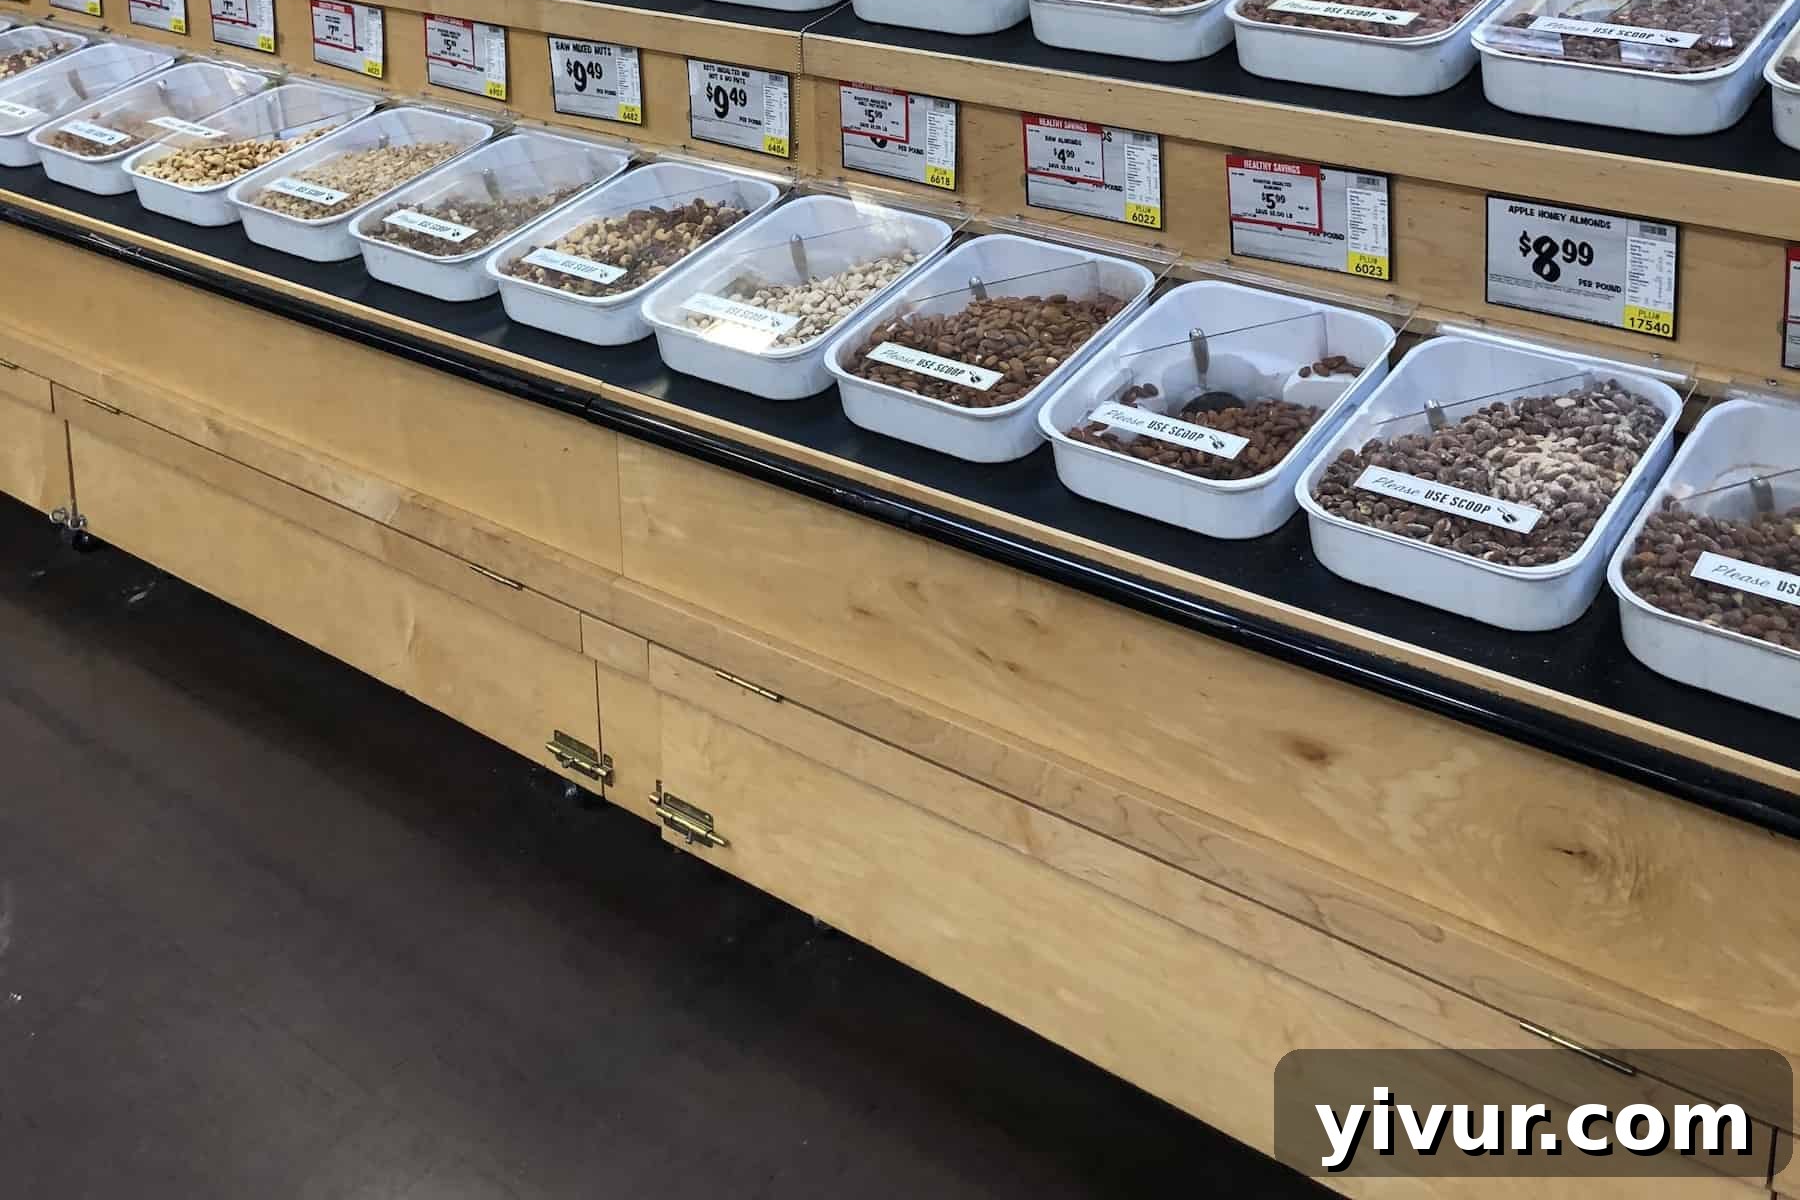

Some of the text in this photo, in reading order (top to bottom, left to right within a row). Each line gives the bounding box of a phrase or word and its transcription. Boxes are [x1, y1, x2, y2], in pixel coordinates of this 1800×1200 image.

[1593, 26, 1614, 35] USE
[1616, 29, 1655, 39] SCOOP
[1039, 118, 1088, 132] HEALTHY SAVINGS
[1244, 159, 1301, 174] HEALTHY SAVINGS
[1132, 213, 1155, 225] 6022
[1508, 205, 1611, 230] APPLE HONEY ALMONDS
[1323, 231, 1345, 240] POUND
[1355, 263, 1383, 276] 6023
[1578, 278, 1622, 294] PER POUND
[1629, 316, 1670, 334] 17540
[916, 358, 934, 369] USE
[934, 363, 966, 377] SCOOP
[1105, 409, 1204, 442] Please USE SCOOP
[1372, 476, 1491, 514] Please USE SCOOP
[1711, 564, 1770, 588] Please
